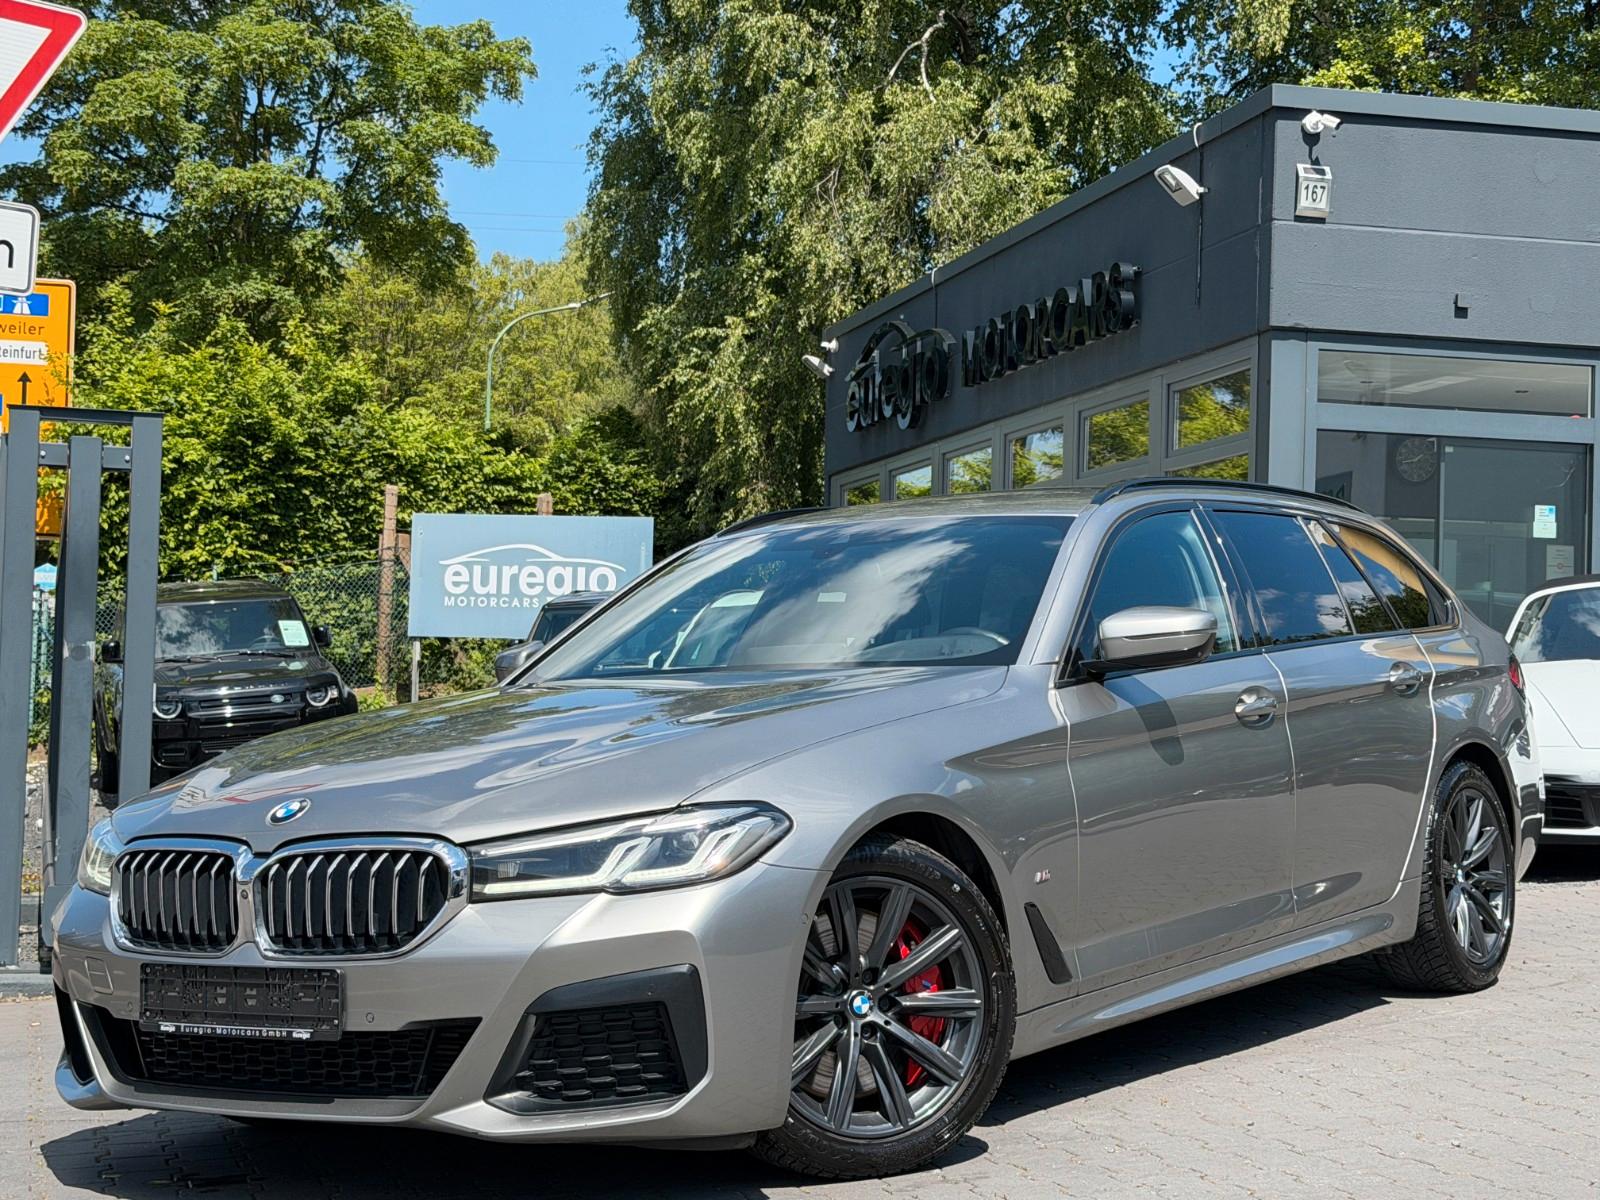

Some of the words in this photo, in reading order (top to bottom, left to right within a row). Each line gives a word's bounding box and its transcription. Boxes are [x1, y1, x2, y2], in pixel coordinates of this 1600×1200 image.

[1304, 184, 1326, 202] 167
[961, 262, 1136, 388] MOTORCARS
[0, 344, 46, 360] einfurt
[444, 596, 540, 608] MOTORCARS
[262, 1030, 287, 1038] GmbH
